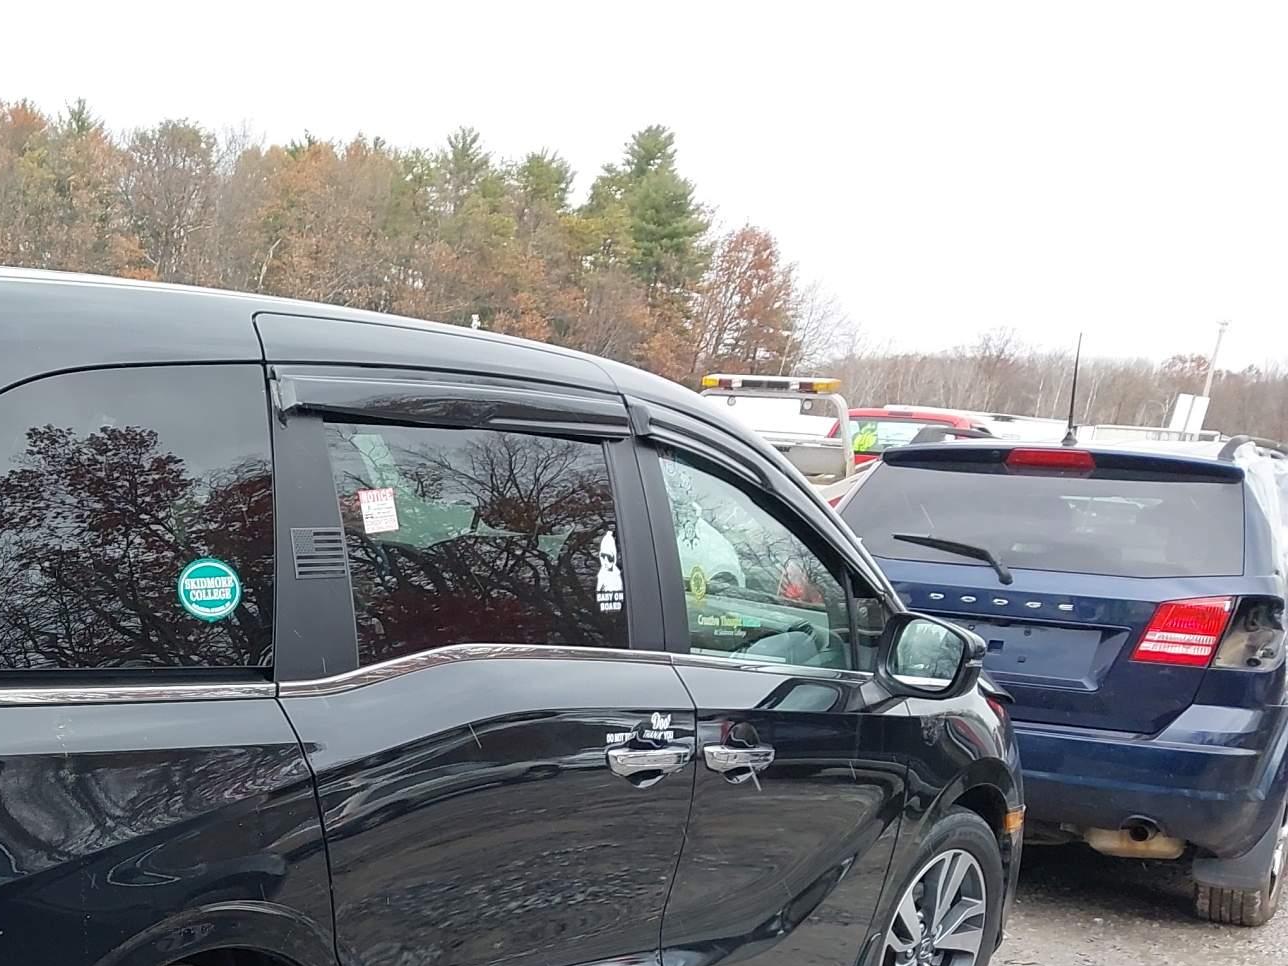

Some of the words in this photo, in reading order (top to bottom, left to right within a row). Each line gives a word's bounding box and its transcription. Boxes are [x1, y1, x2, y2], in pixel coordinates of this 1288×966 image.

[184, 576, 234, 590] SKIDMORE
[190, 588, 232, 601] COLLEGE
[596, 592, 613, 602] BABY
[614, 592, 624, 601] ON
[600, 602, 622, 611] BOARD
[929, 592, 1074, 611] DODGE
